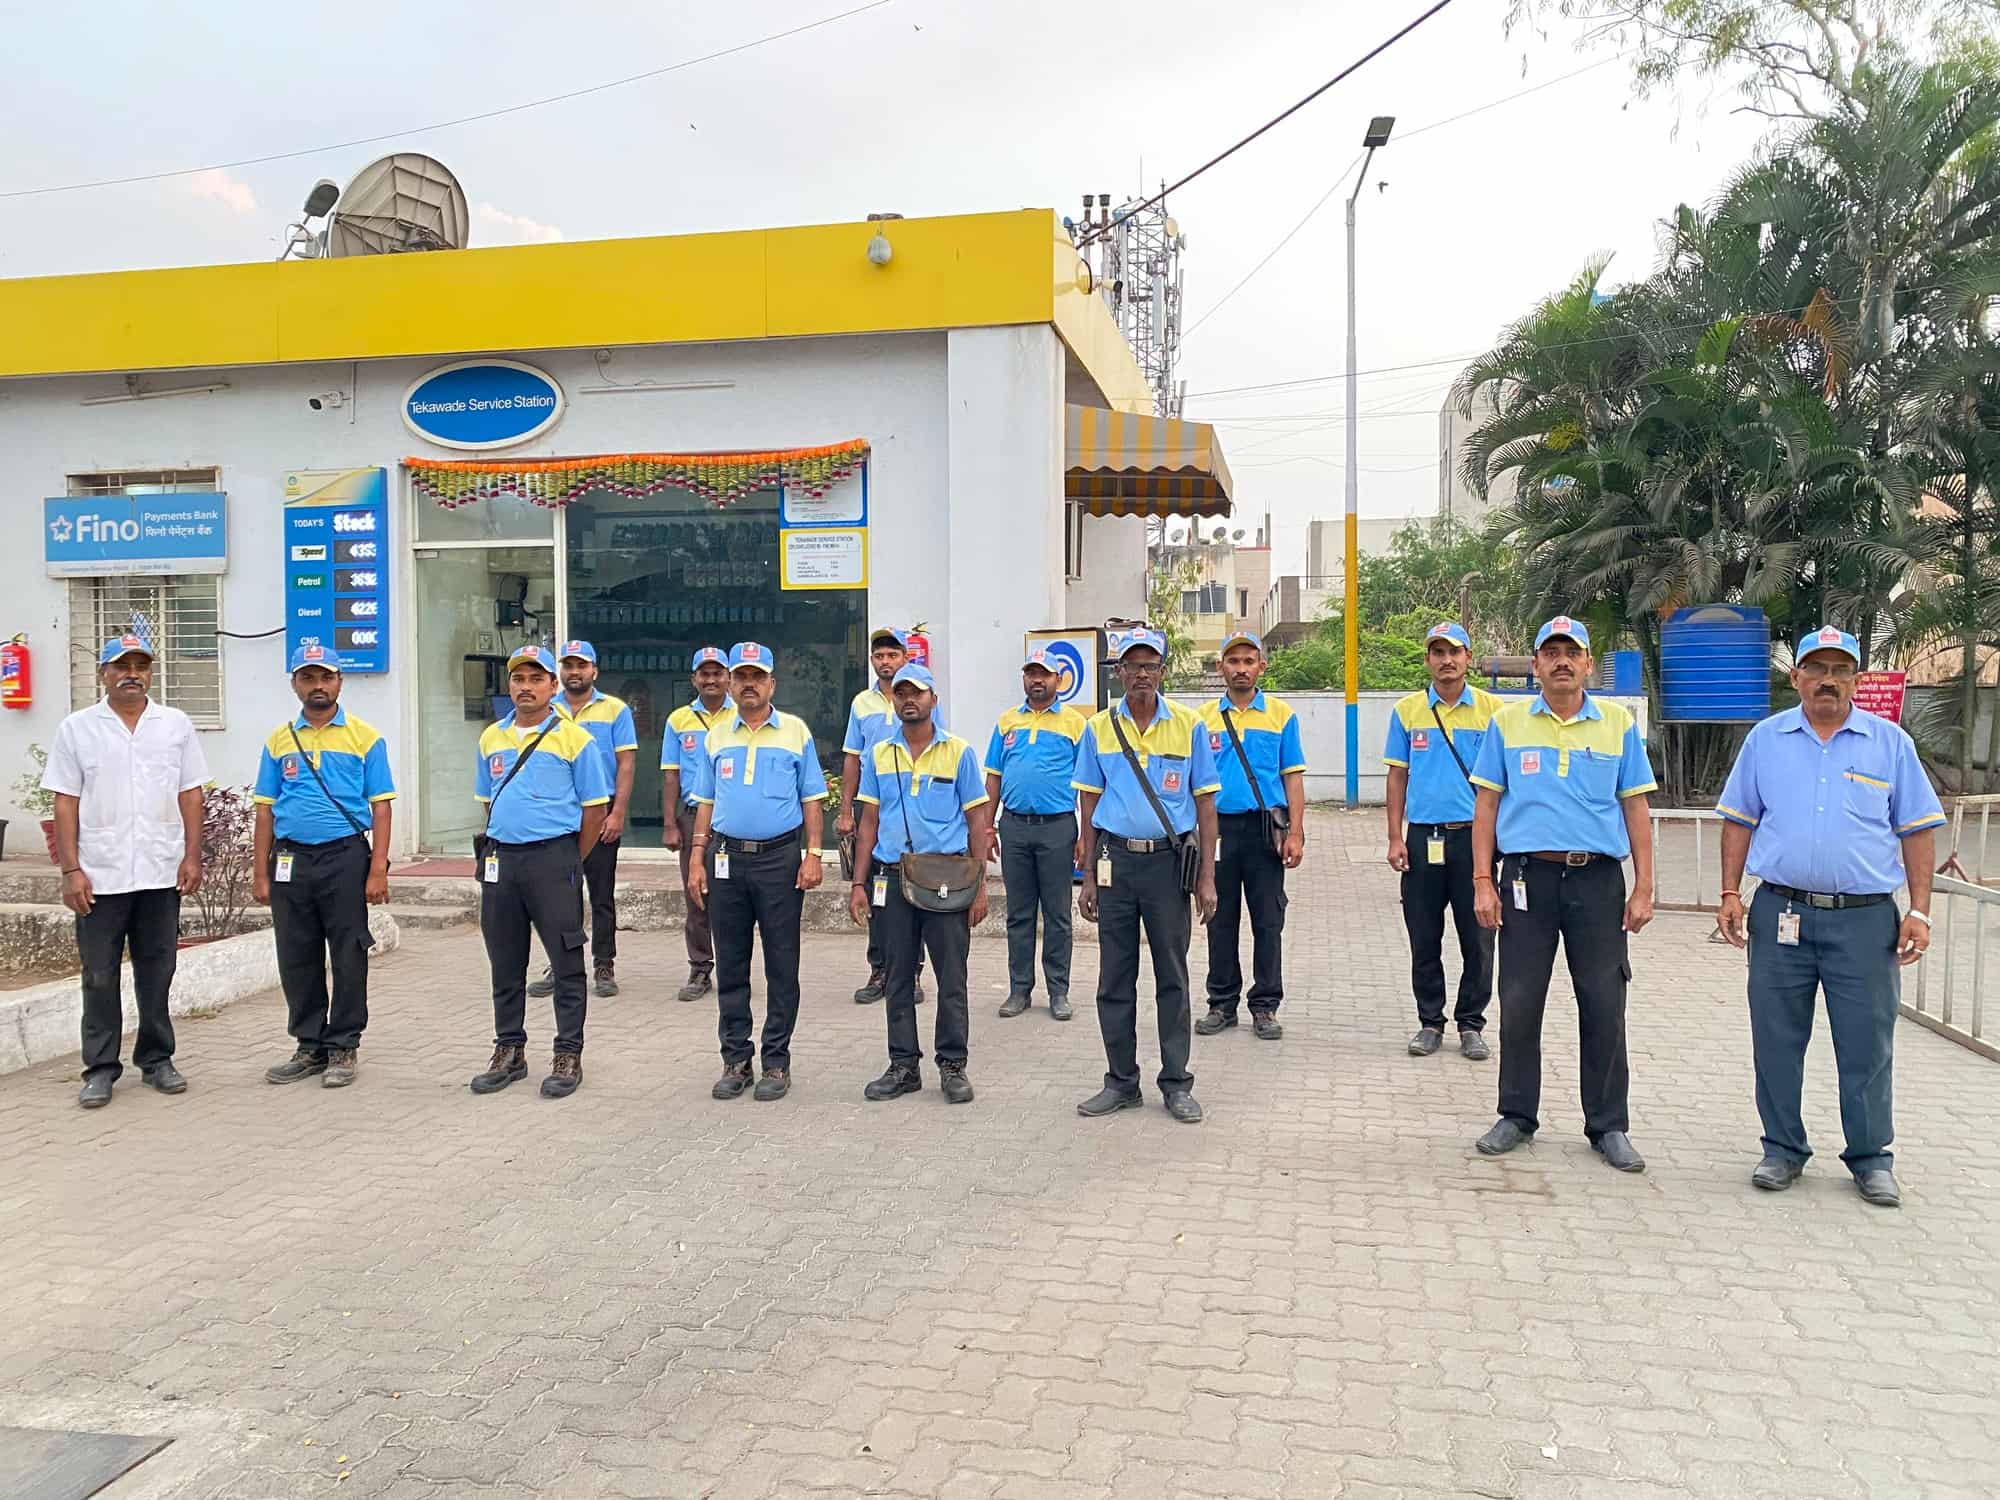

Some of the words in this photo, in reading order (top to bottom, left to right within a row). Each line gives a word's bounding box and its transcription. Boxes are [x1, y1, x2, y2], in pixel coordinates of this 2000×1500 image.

[409, 400, 466, 414] Tekawade
[468, 397, 512, 411] Service
[513, 395, 554, 408] Station
[144, 512, 193, 523] Payments
[194, 509, 219, 520] Bank
[76, 513, 140, 543] Fino
[297, 576, 321, 586] Petrol
[297, 607, 322, 617] Diesel
[300, 636, 320, 646] CNG
